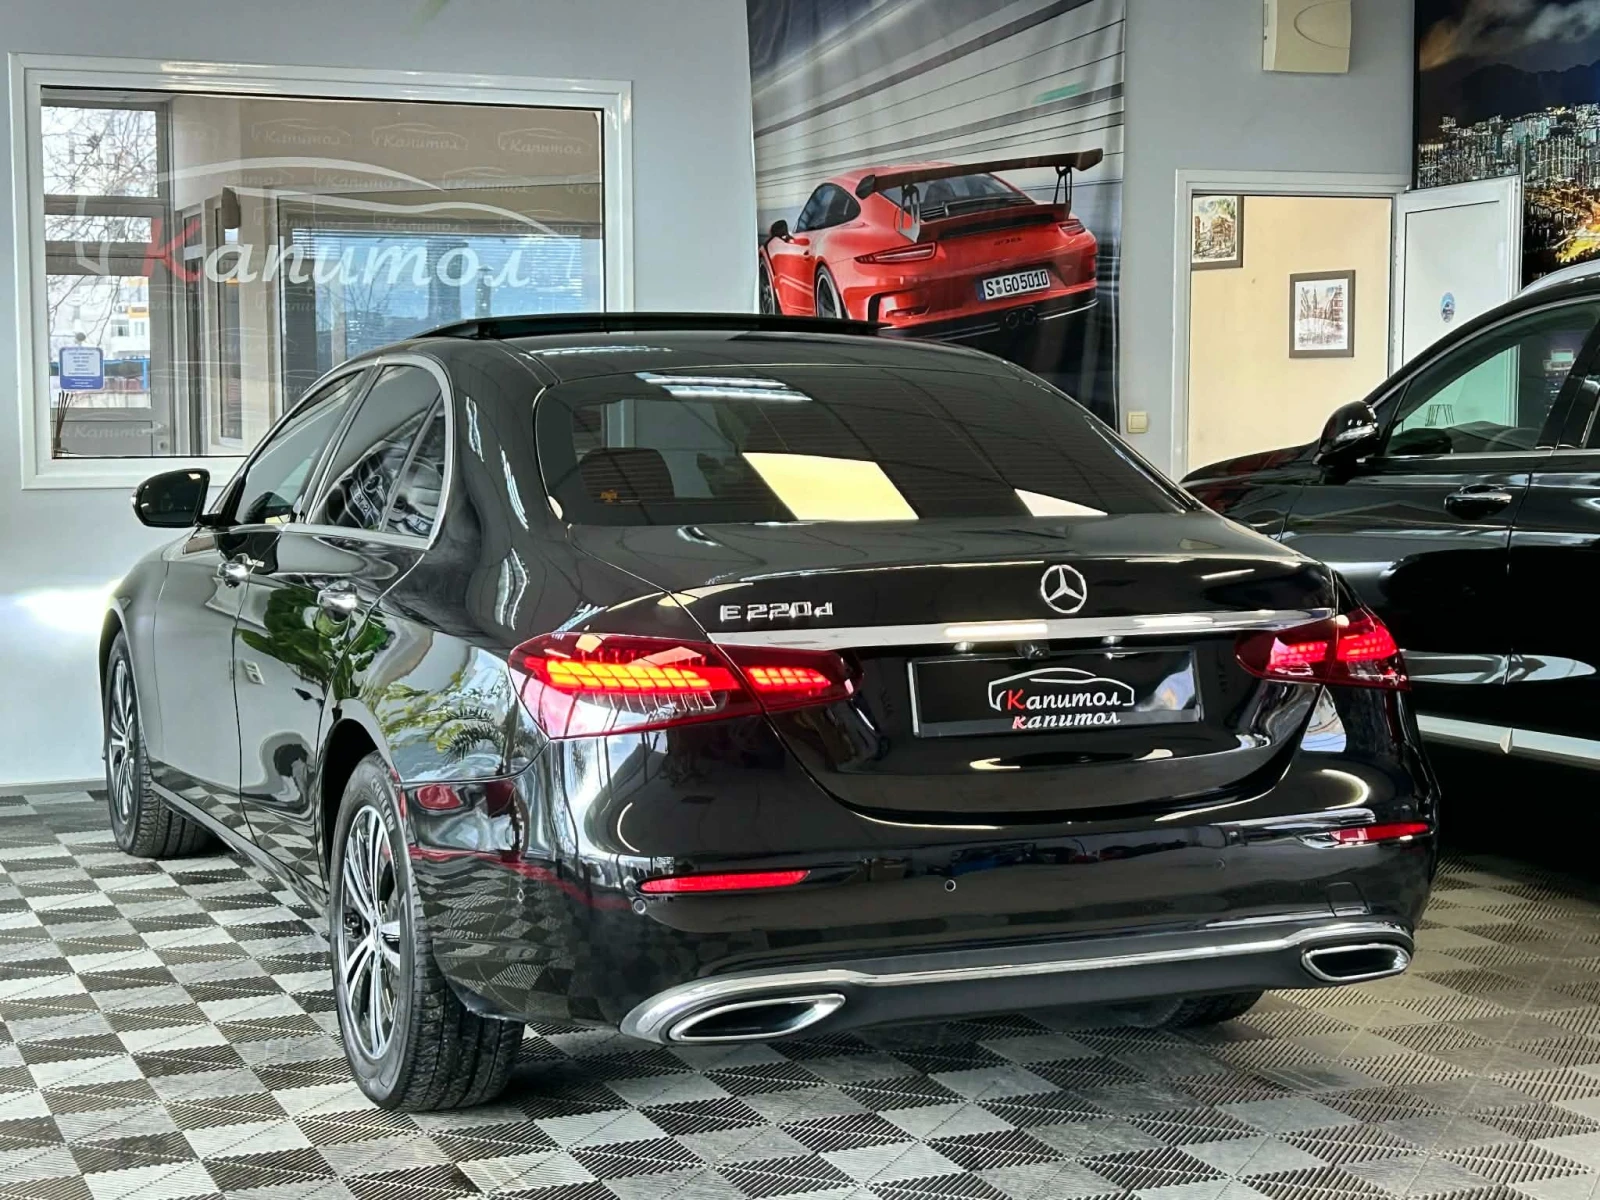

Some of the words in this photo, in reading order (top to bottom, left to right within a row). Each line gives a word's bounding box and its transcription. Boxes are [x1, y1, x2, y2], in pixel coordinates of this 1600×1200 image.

[142, 218, 530, 287] Капитол
[720, 604, 741, 622] E
[747, 601, 834, 622] 220d
[1006, 688, 1121, 711] Капитол
[1012, 711, 1121, 730] капитол
